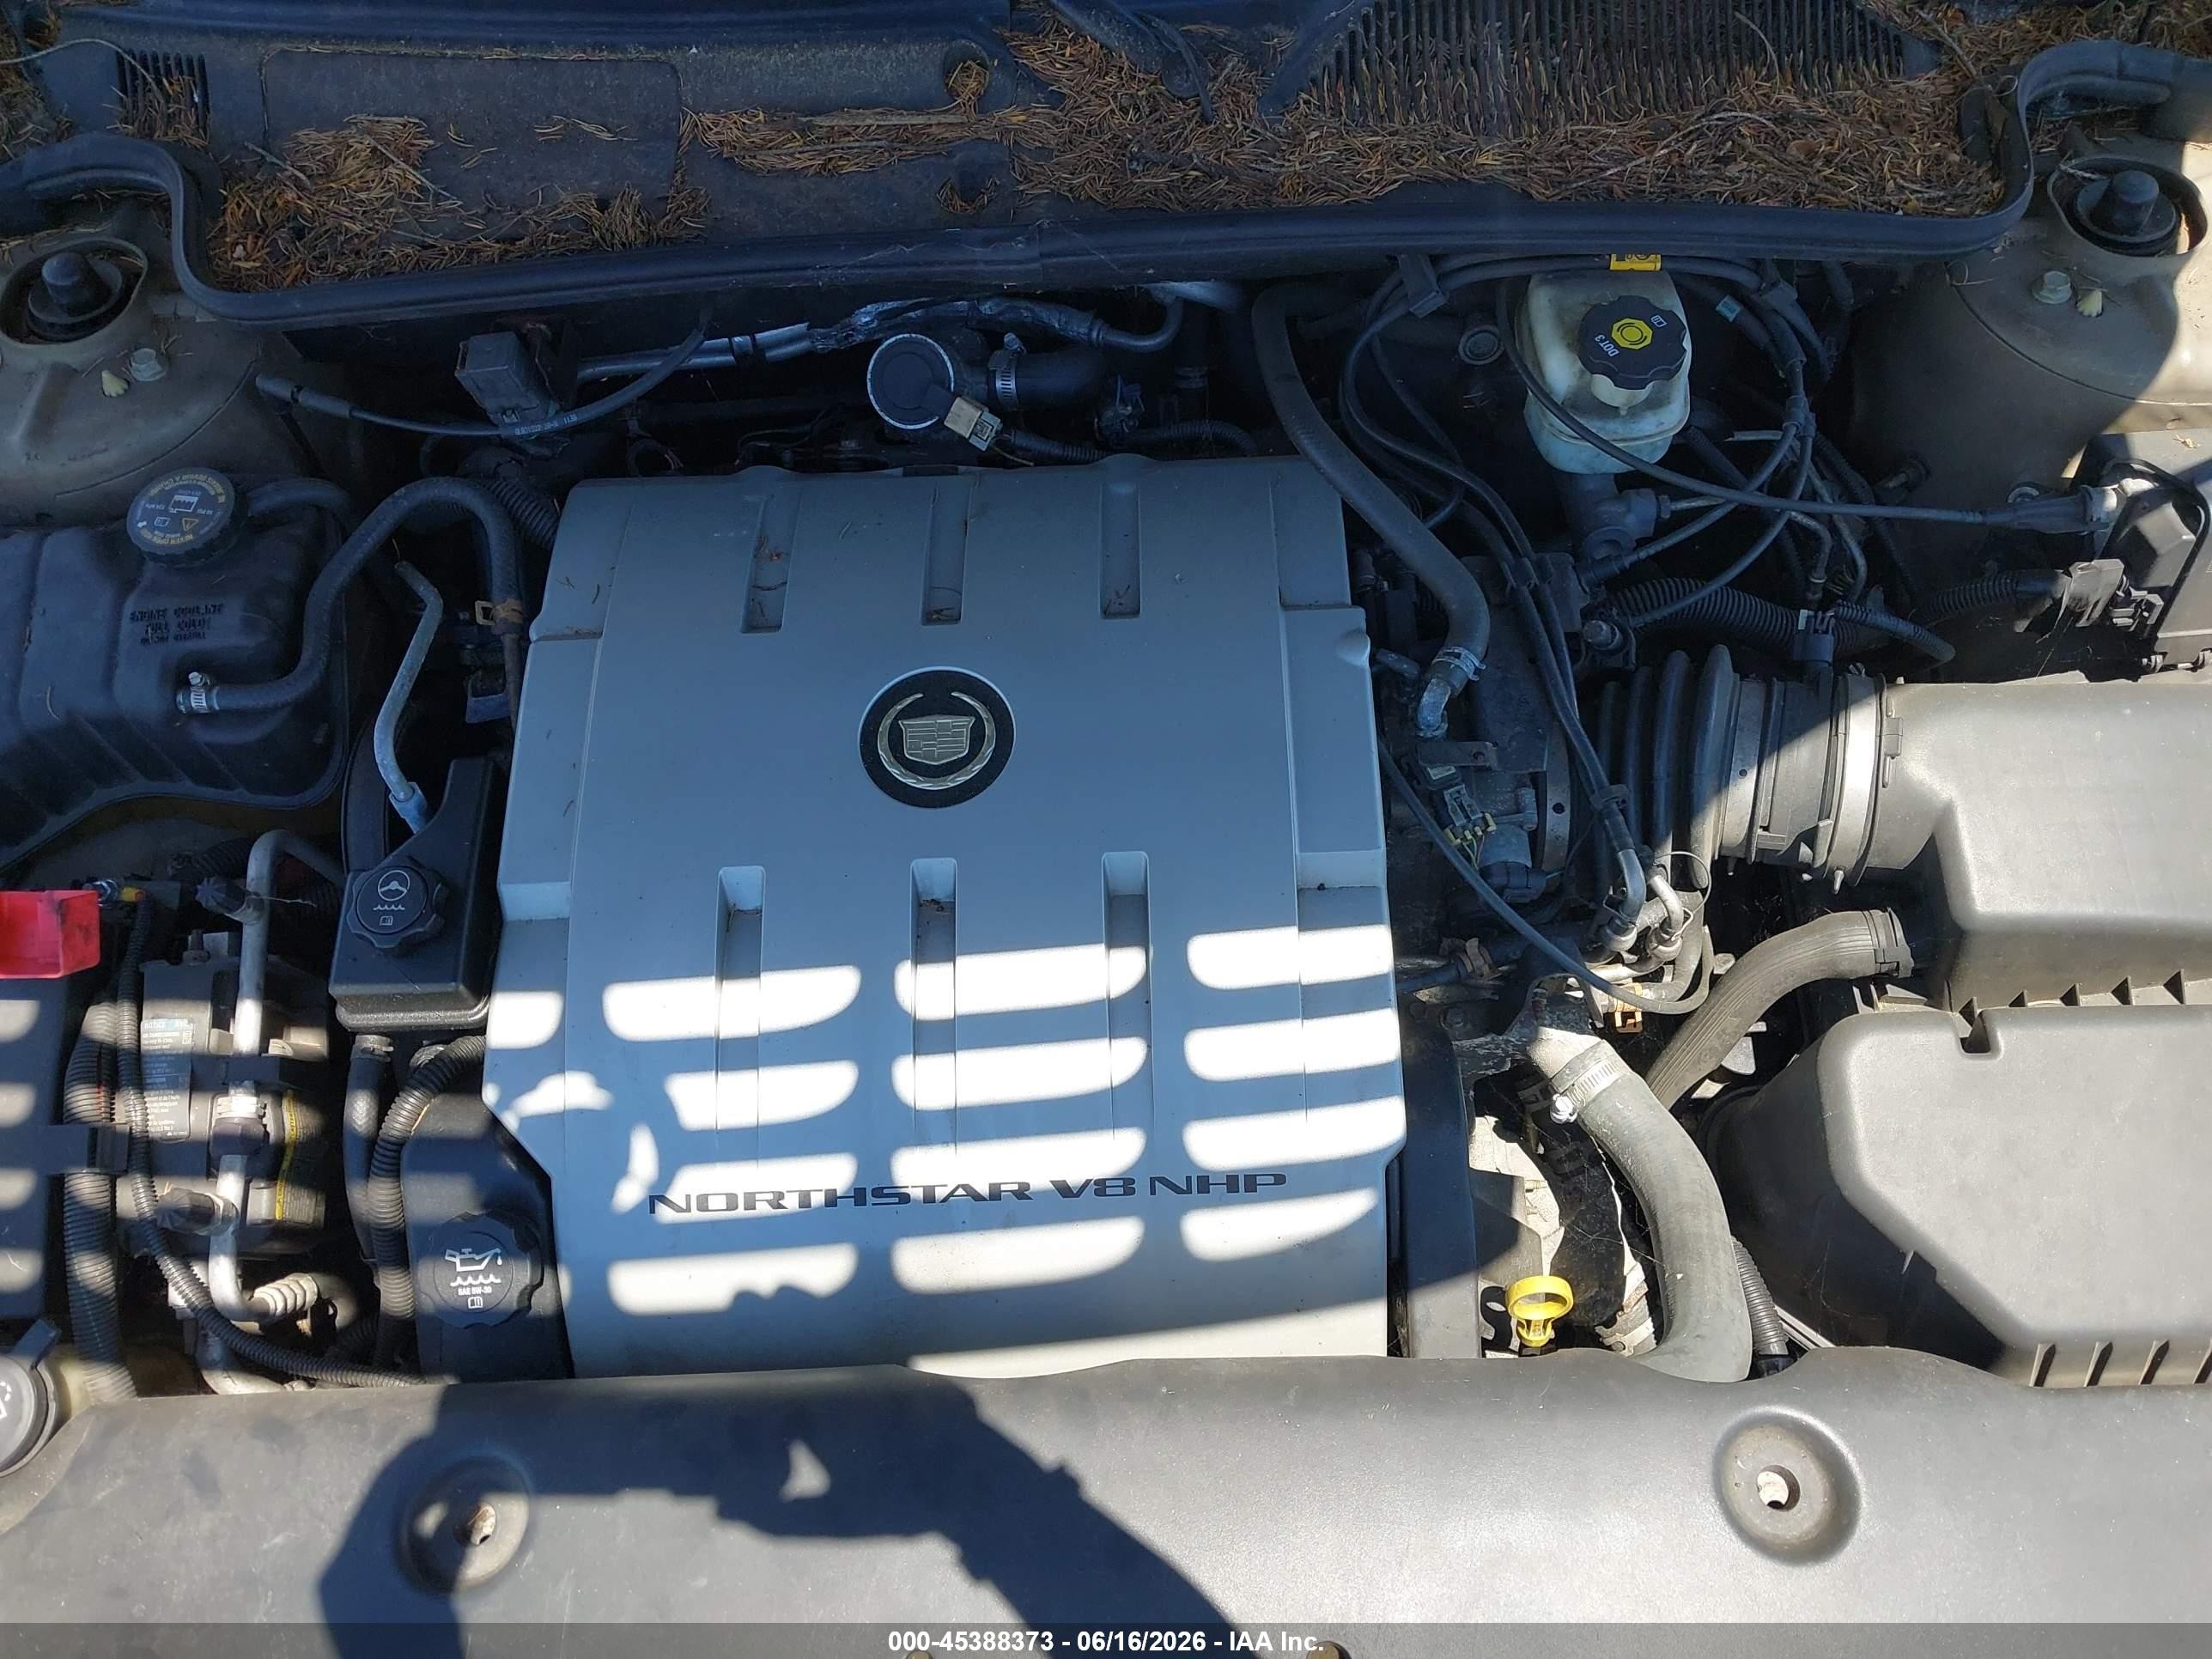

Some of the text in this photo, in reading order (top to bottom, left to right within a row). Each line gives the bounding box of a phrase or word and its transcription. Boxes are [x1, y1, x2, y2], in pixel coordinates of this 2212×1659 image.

[648, 1173, 1287, 1215] NORTHSTAR V8 NHP
